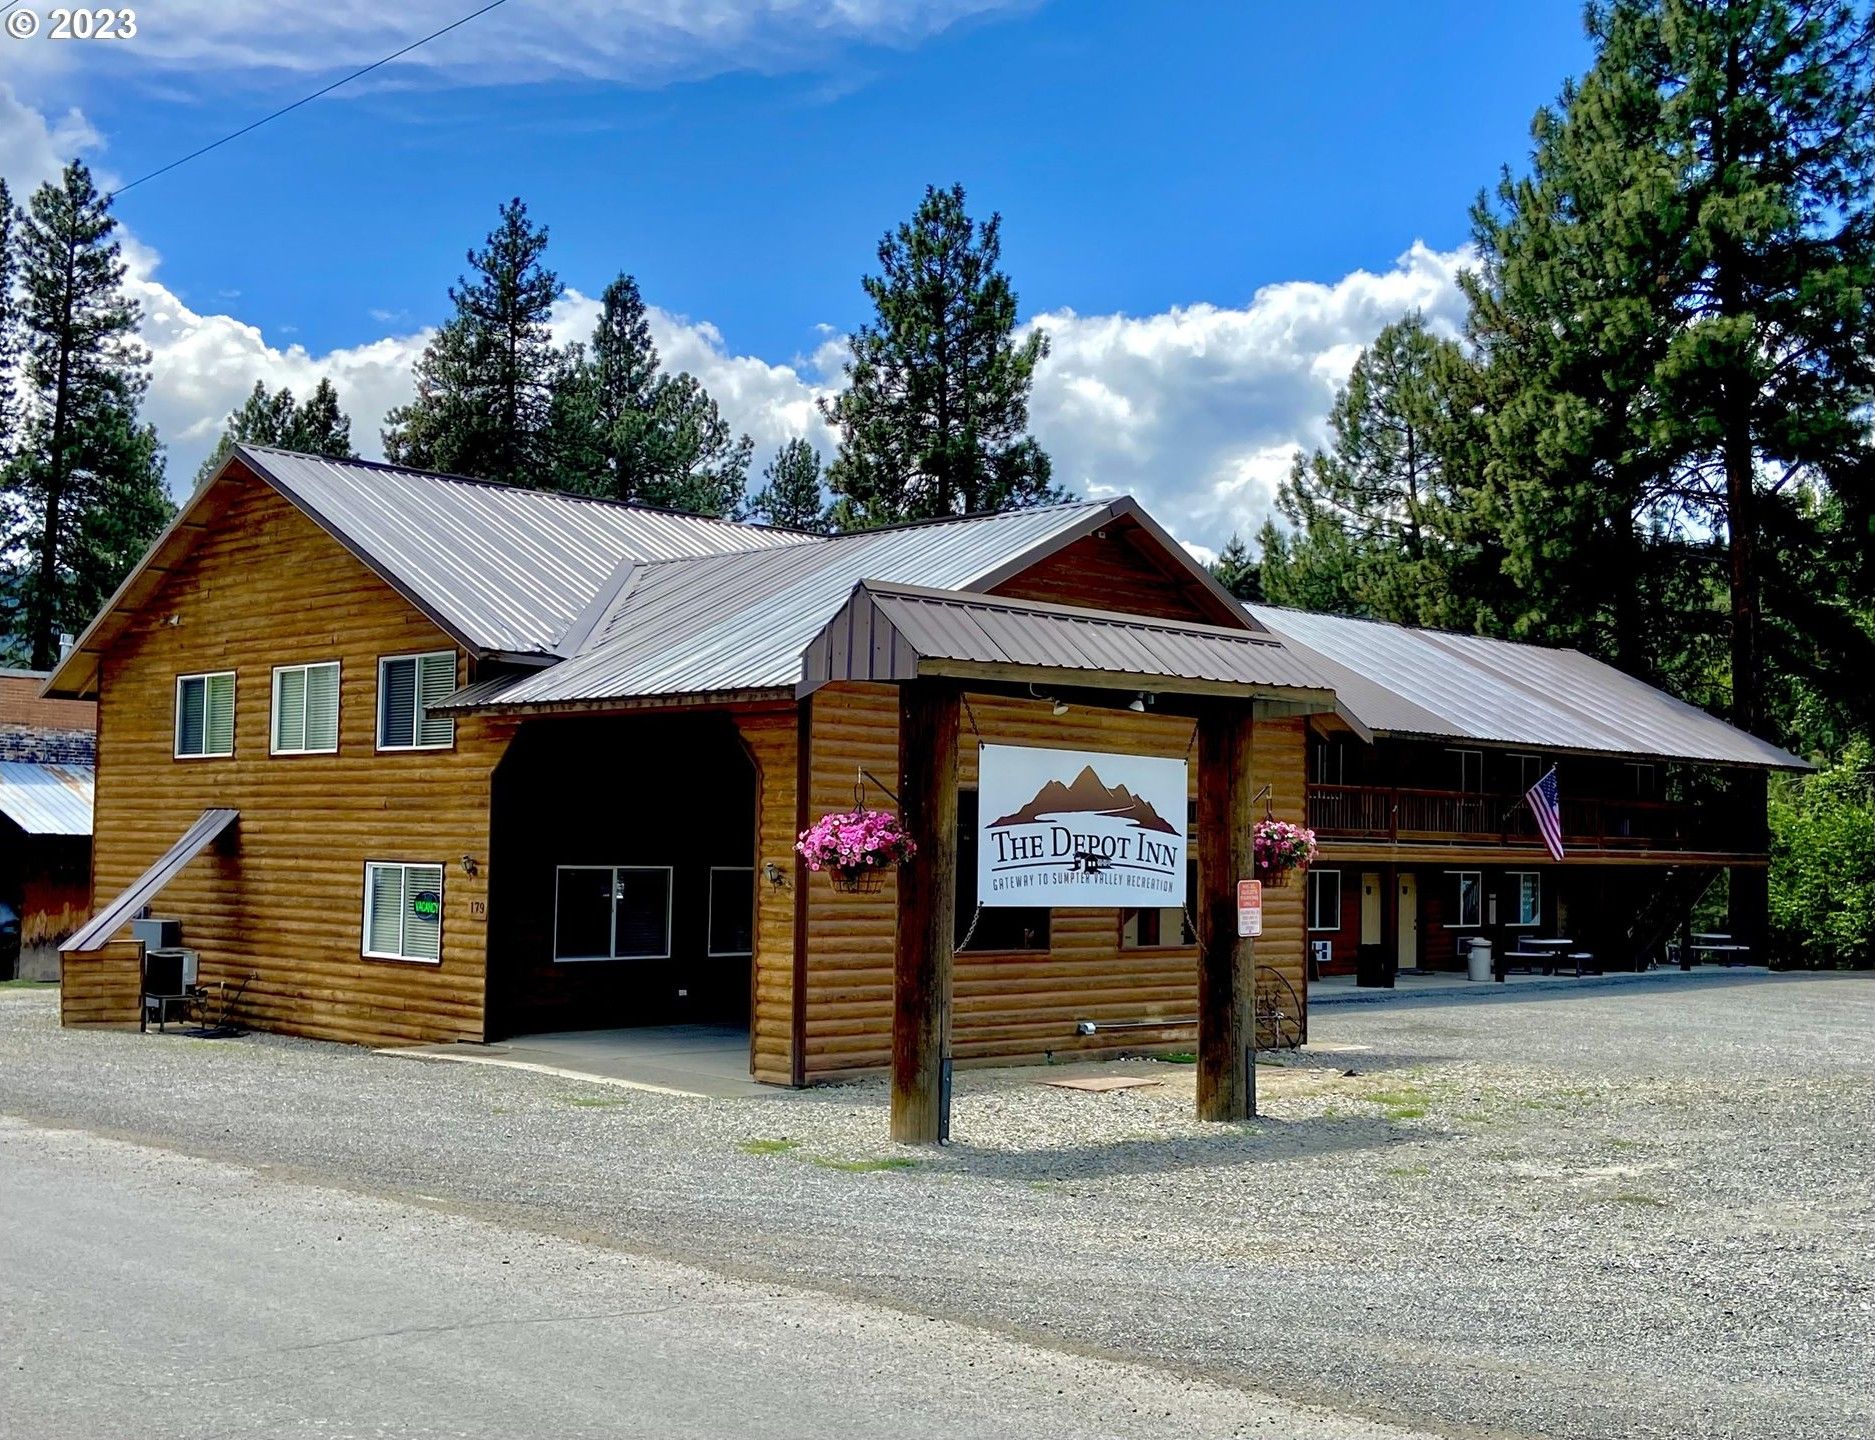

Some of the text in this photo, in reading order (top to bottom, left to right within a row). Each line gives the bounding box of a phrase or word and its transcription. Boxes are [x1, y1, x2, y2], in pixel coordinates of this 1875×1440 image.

[991, 826, 1178, 868] THE DEPOT INN
[992, 871, 1174, 893] GATEWAY TO SUMPTER VALLEY RECREATION
[415, 901, 439, 914] VACANCY
[470, 901, 485, 914] 179
